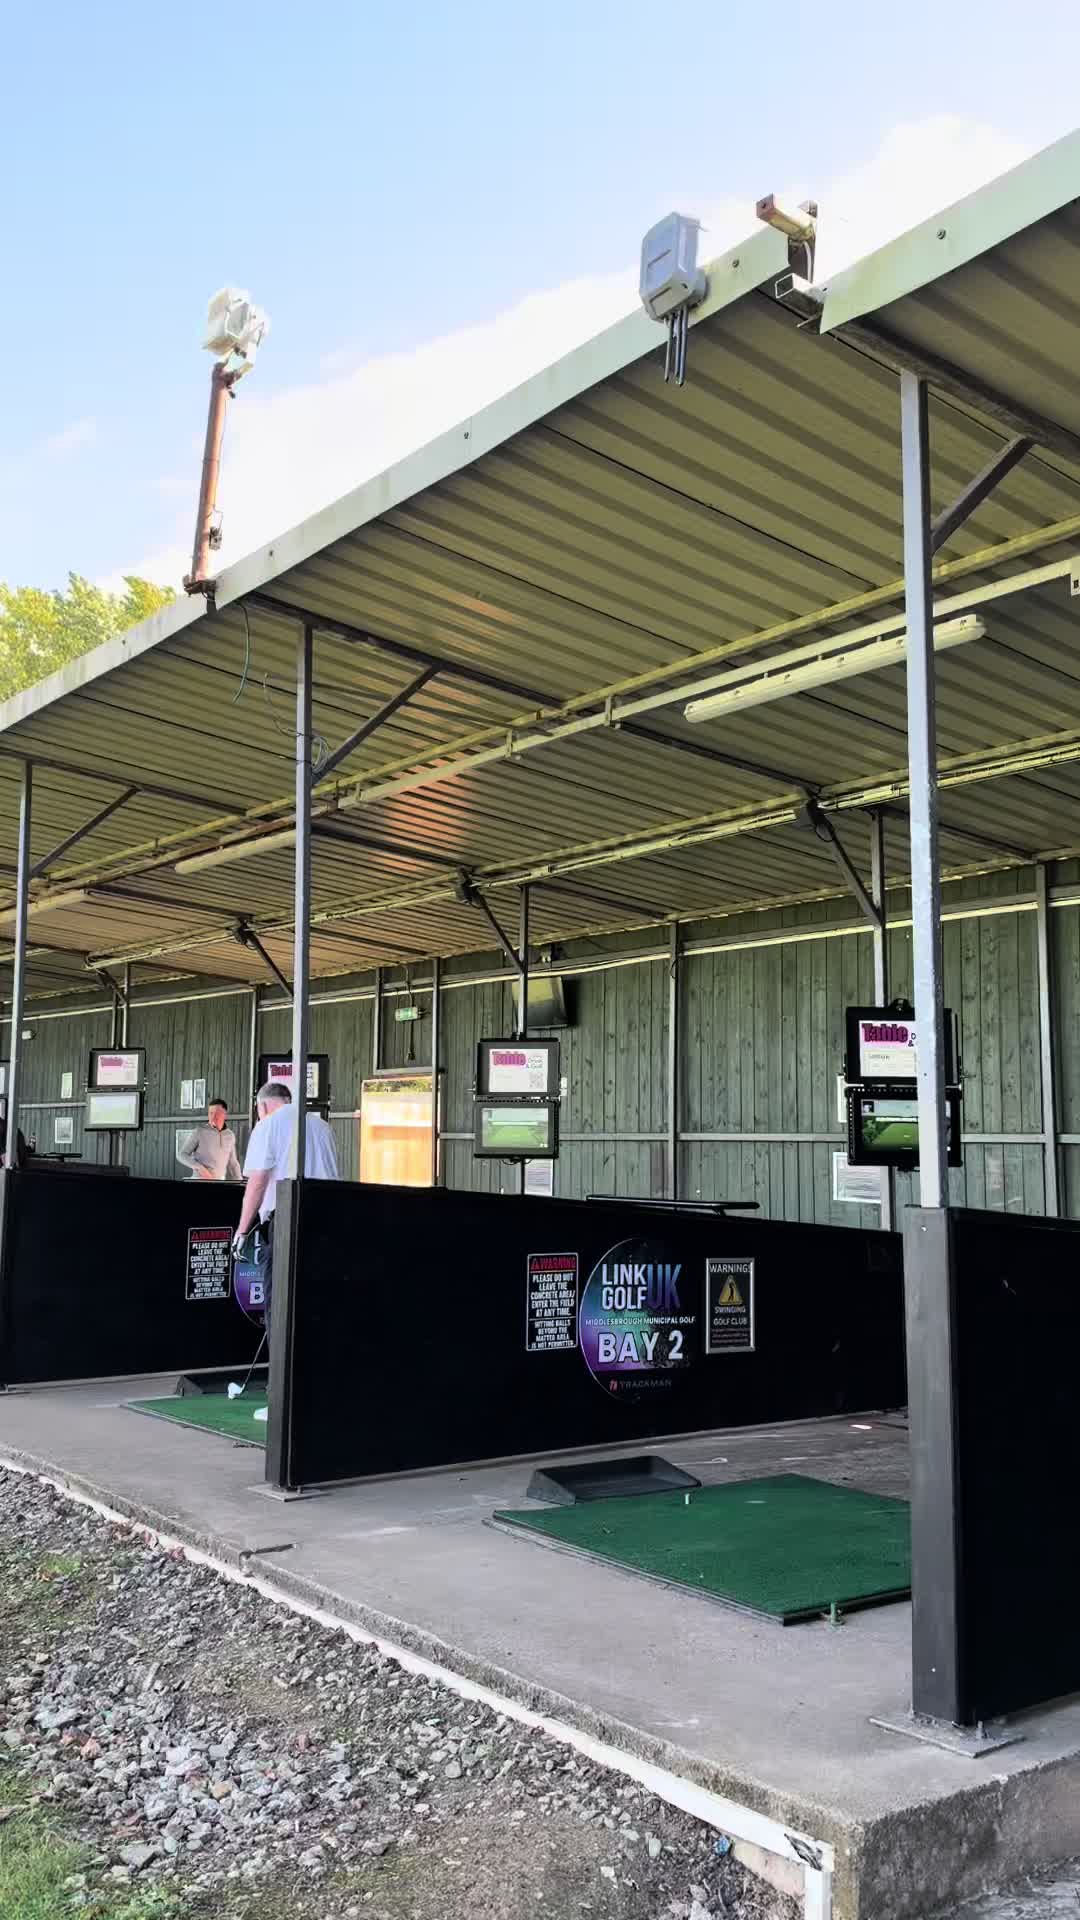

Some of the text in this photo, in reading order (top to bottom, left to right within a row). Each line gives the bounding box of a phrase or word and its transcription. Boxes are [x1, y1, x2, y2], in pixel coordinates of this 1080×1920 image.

[538, 1257, 576, 1269] WARNING
[533, 1272, 574, 1282] PLEASE DO NOT
[539, 1282, 568, 1291] LEAVE THE
[602, 1263, 682, 1310] LINK UK
[530, 1291, 558, 1300] CONCRETE
[602, 1286, 648, 1310] GOLF
[532, 1300, 548, 1309] ENTER
[560, 1299, 574, 1307] FIELD
[536, 1309, 542, 1317] AT
[544, 1308, 555, 1317] ANY
[555, 1319, 571, 1327] BALLS
[586, 1316, 696, 1326] MIDDLESBROUGH MUNICIPAL GOLF
[731, 1317, 748, 1325] CLUB
[598, 1331, 660, 1363] BAY
[668, 1330, 683, 1360] 2
[619, 1380, 672, 1390] TRACKMAN
